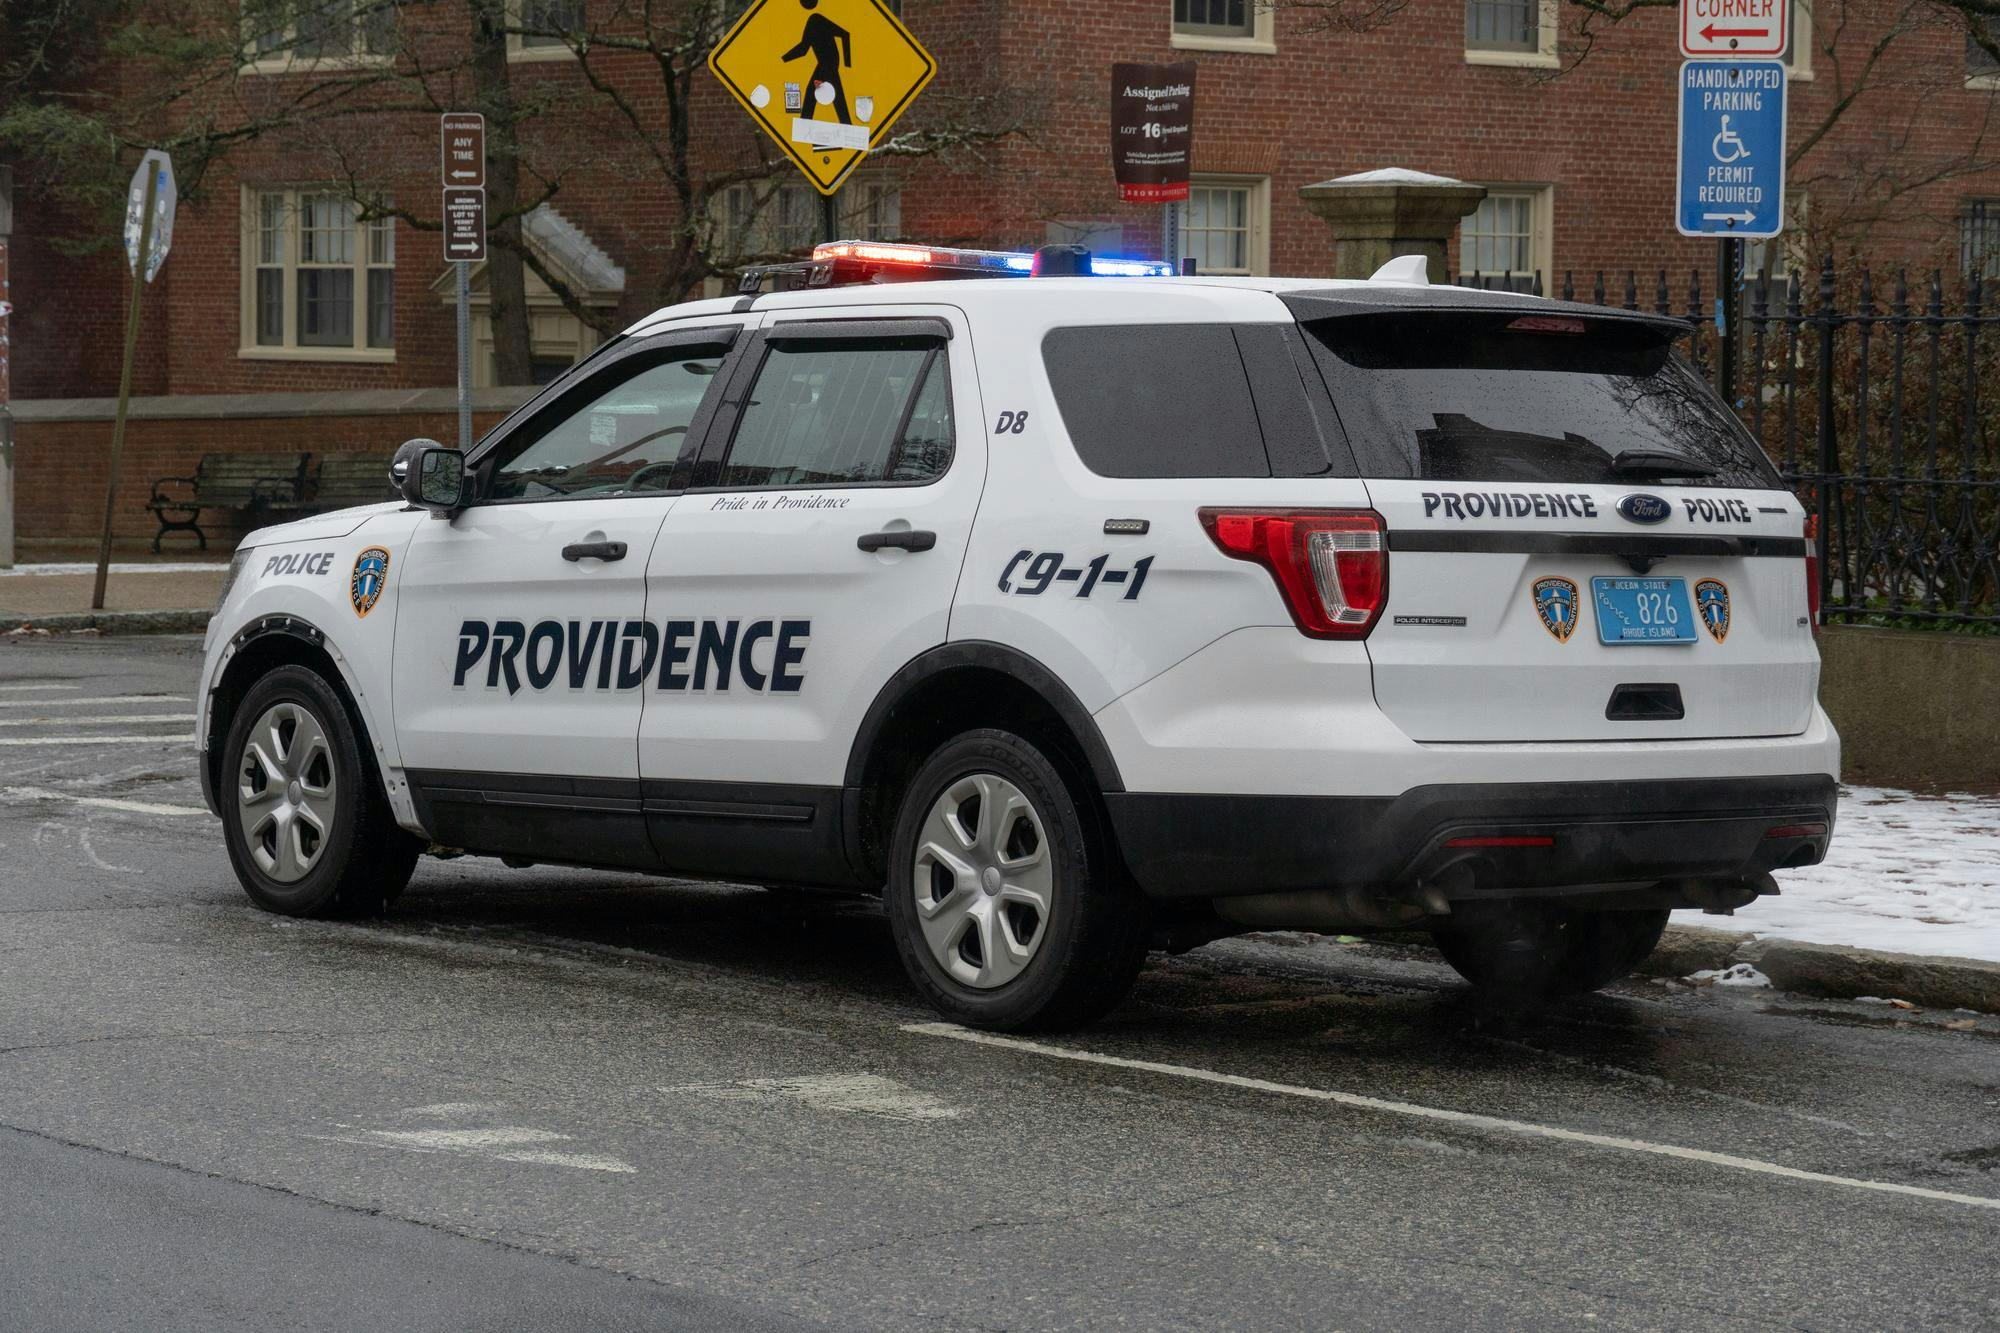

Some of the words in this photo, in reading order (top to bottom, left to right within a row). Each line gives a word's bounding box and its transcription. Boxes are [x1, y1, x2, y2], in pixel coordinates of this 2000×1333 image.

[1696, 0, 1773, 17] CORNER
[1687, 69, 1780, 89] HANDICAPPED
[1123, 85, 1168, 100] Assigned
[1703, 92, 1762, 111] PARKING
[1120, 126, 1138, 135] LOT
[1142, 122, 1160, 138] 16
[453, 137, 473, 147] ANY
[452, 150, 474, 160] TIME
[1708, 166, 1754, 183] PERMIT
[1126, 189, 1160, 197] BROWN
[1699, 186, 1762, 203] REQUIRED
[452, 211, 466, 219] LOT
[467, 211, 475, 219] 16
[994, 410, 1029, 435] D8
[710, 496, 749, 511] Pride
[752, 496, 769, 510] in
[772, 494, 850, 510] Providence
[1421, 492, 1597, 521] PROVIDENCE
[1681, 498, 1752, 523] POLICE
[1632, 497, 1662, 516] Ford
[260, 552, 335, 578] POLICE
[352, 567, 361, 606] POLICE
[1536, 580, 1574, 591] PROVIDENCE
[1615, 581, 1640, 590] OCEAN
[1643, 581, 1667, 590] STATE
[1535, 596, 1557, 632] POLICE
[1564, 592, 1577, 634] DEPARTMENT
[1600, 592, 1631, 625] POLICE
[1636, 592, 1678, 625] 826
[1421, 617, 1464, 625] INTERCEPTOR
[1622, 627, 1646, 638] RHODE
[1648, 627, 1677, 638] ISLAND
[452, 619, 812, 698] PROVIDENCE
